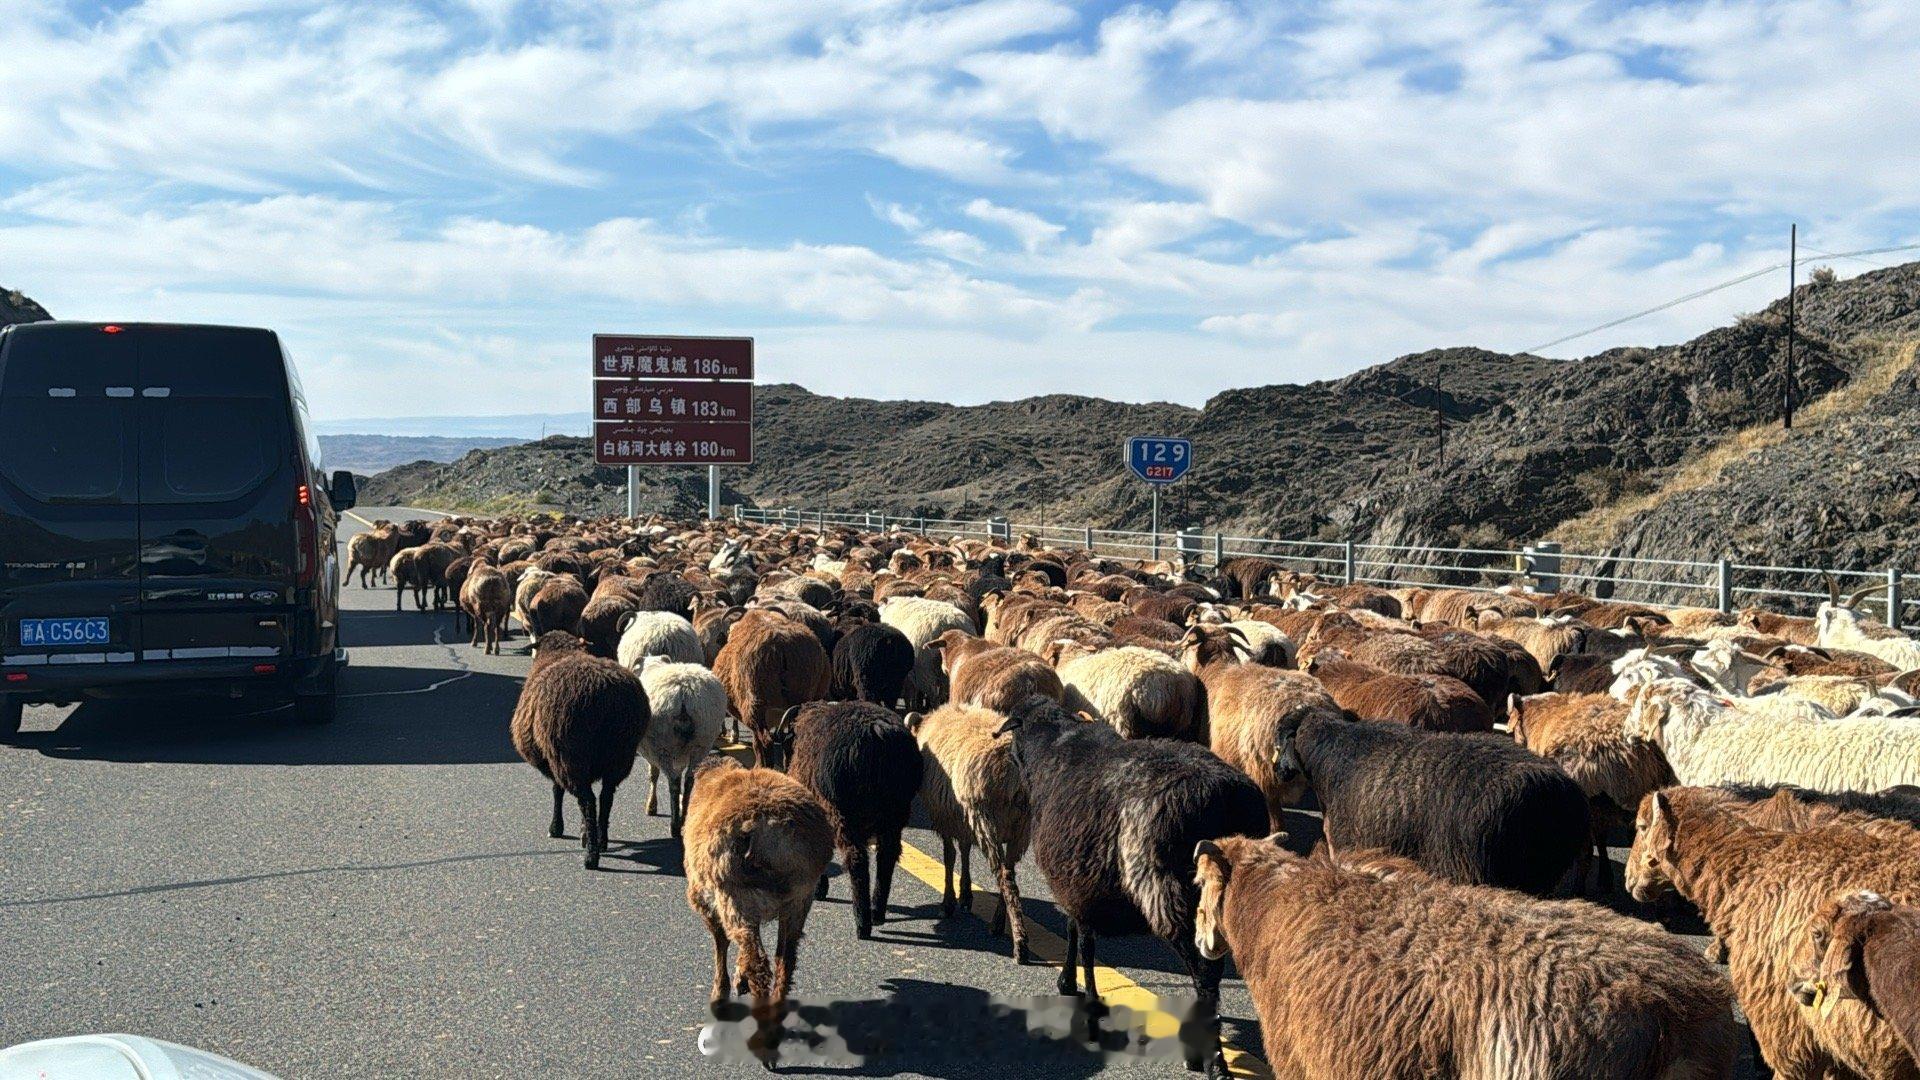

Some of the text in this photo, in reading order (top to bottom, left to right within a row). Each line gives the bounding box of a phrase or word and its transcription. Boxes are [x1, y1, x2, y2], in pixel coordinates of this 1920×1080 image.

[602, 355, 738, 375] 世界魔鬼城 186 km
[602, 397, 736, 417] 西部乌镇 183 km
[603, 440, 736, 457] 白杨河大峡谷 180 km
[1141, 443, 1185, 462] 129
[1146, 466, 1174, 477] G217
